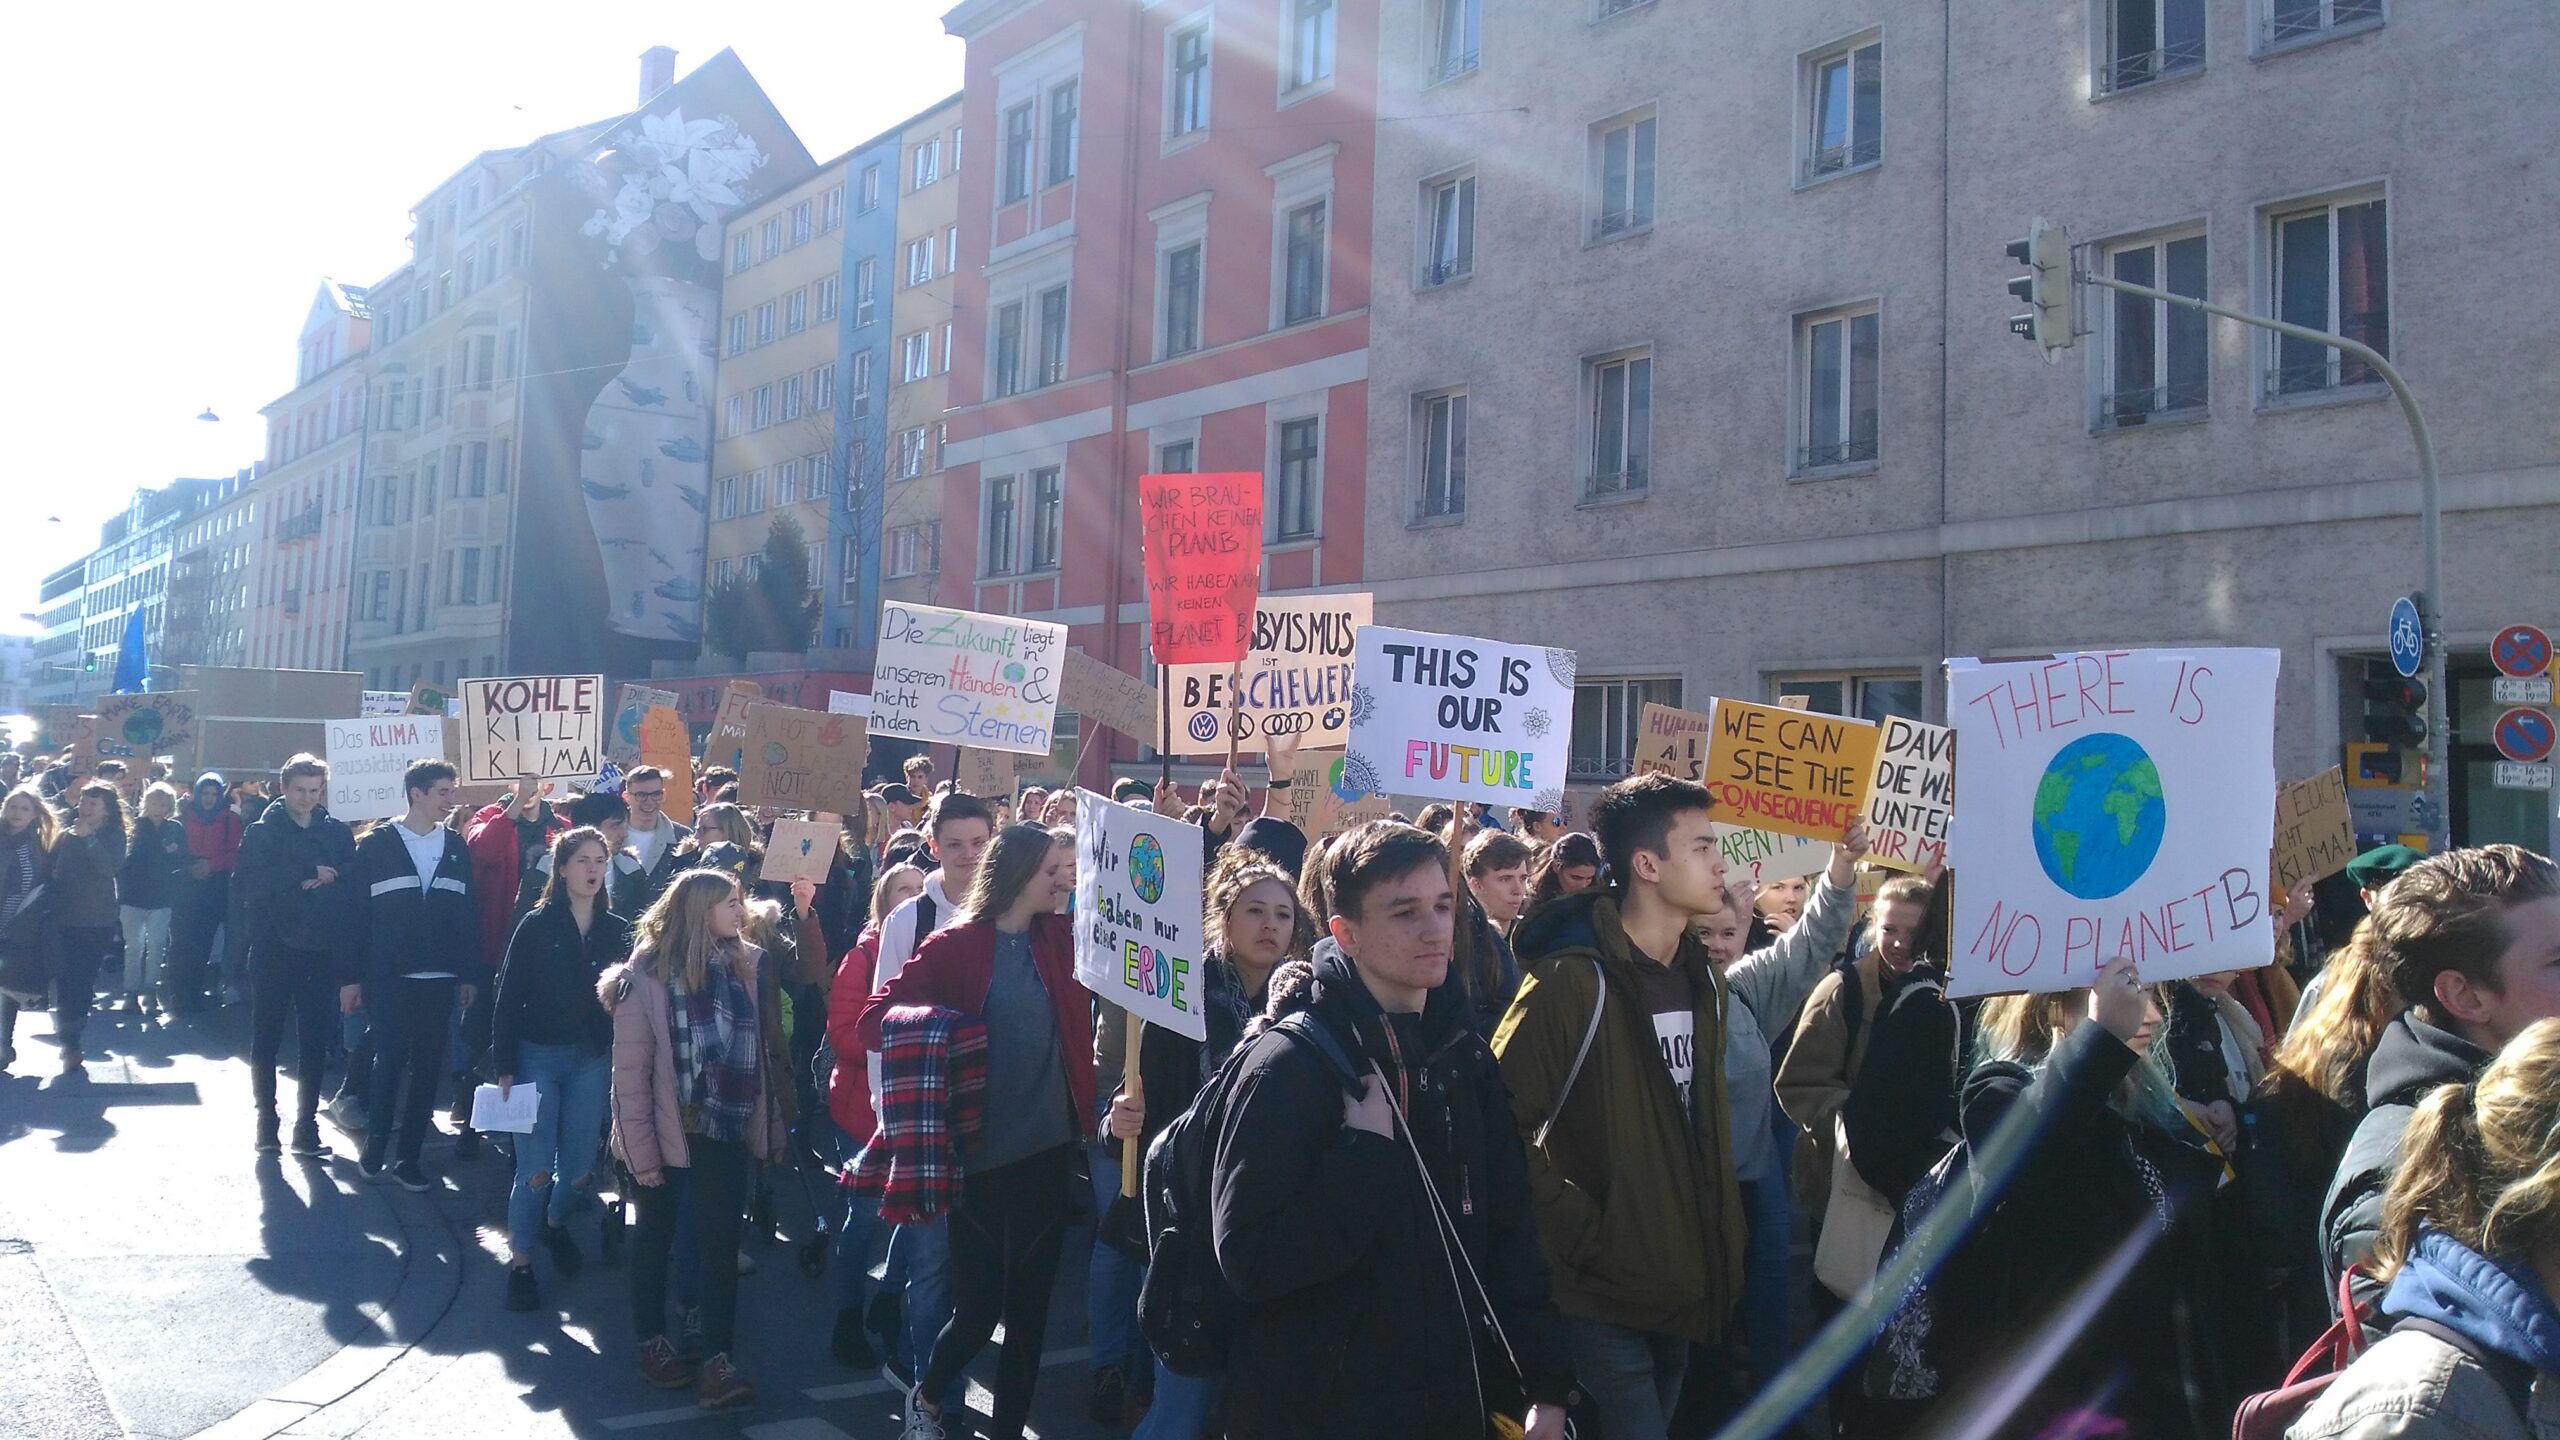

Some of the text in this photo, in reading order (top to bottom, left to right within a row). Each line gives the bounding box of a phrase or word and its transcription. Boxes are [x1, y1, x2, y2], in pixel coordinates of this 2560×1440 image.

[1147, 484, 1251, 509] WIR BRAU-
[1148, 508, 1262, 533] CHEN KEINEN
[1168, 533, 1216, 557] PLAN
[1151, 576, 1179, 592] WIR
[1187, 574, 1239, 590] HABEN
[1177, 599, 1222, 611] KEINEN
[883, 607, 1055, 658] Die Zukunft liegt
[1155, 613, 1248, 648] PLANET B
[1024, 648, 1039, 662] in
[1262, 658, 1278, 666] IST
[1383, 644, 1531, 697] THIS IS
[483, 679, 593, 715] KOHLE
[876, 664, 946, 688] unseren
[949, 654, 1018, 699] Händen
[1022, 667, 1055, 704] &
[1118, 676, 1148, 704] Erde
[1184, 661, 1355, 709] BESCHEUER
[873, 688, 919, 709] nicht
[1438, 694, 1502, 733] OUR
[1969, 653, 2213, 750] THERE IS
[333, 723, 439, 750] Das KLIMA ist
[486, 711, 592, 744] KILLT
[755, 717, 816, 742] A HOT
[930, 694, 1047, 748] Sternen
[1724, 708, 1844, 754] WE CAN
[488, 745, 593, 778] KLIMA
[1405, 740, 1533, 789] FUTURE
[1731, 748, 1855, 797] SEE THE
[1876, 760, 1917, 795] DIE
[335, 786, 361, 804] als
[367, 785, 395, 801] mein
[2292, 771, 2346, 817] EUCH
[1090, 823, 1118, 872] Wir
[1866, 826, 1908, 863] WIR
[1097, 885, 1179, 942] haben nur
[1970, 868, 2260, 976] NO PLANET B
[1093, 921, 1189, 1012] eine ERDE
